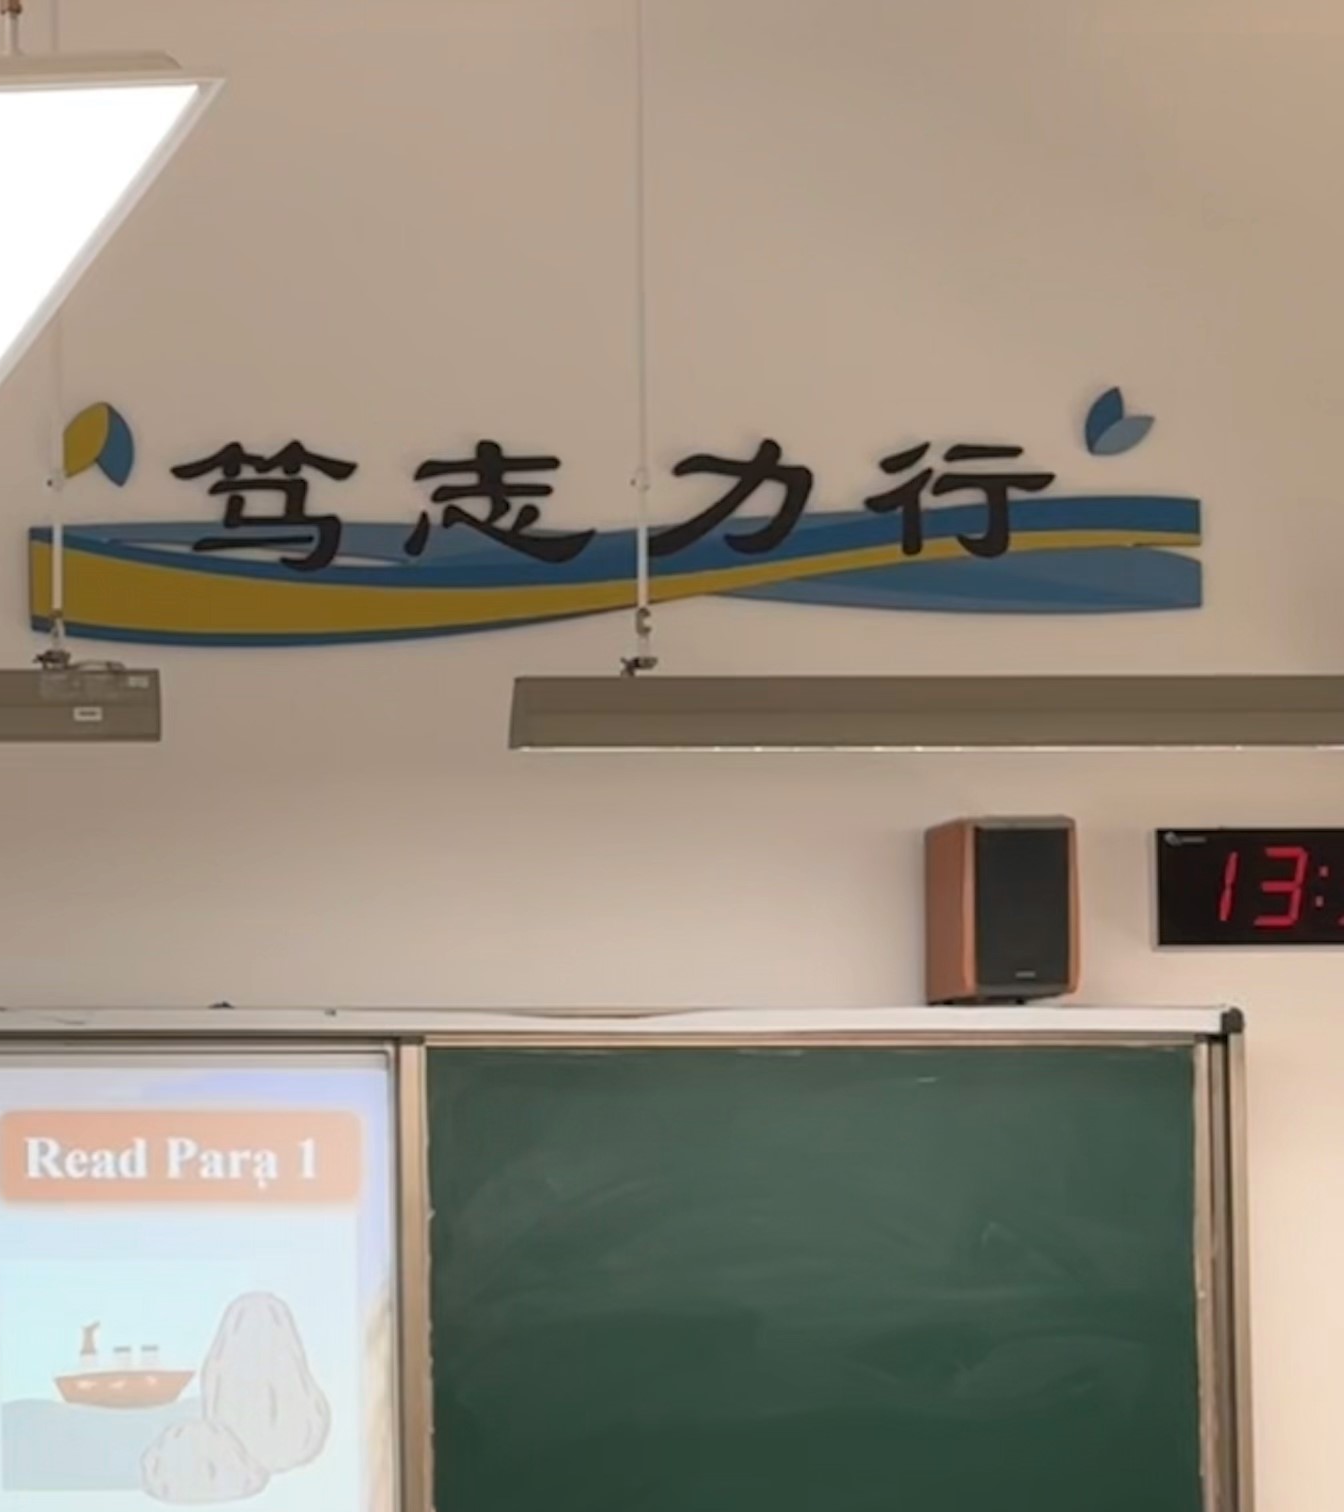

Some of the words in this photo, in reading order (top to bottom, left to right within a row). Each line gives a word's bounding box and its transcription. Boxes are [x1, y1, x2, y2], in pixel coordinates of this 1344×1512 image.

[171, 438, 1055, 570] 笃志力行
[23, 1136, 148, 1179] Read
[165, 1136, 279, 1181] Para
[296, 1137, 318, 1179] 1
